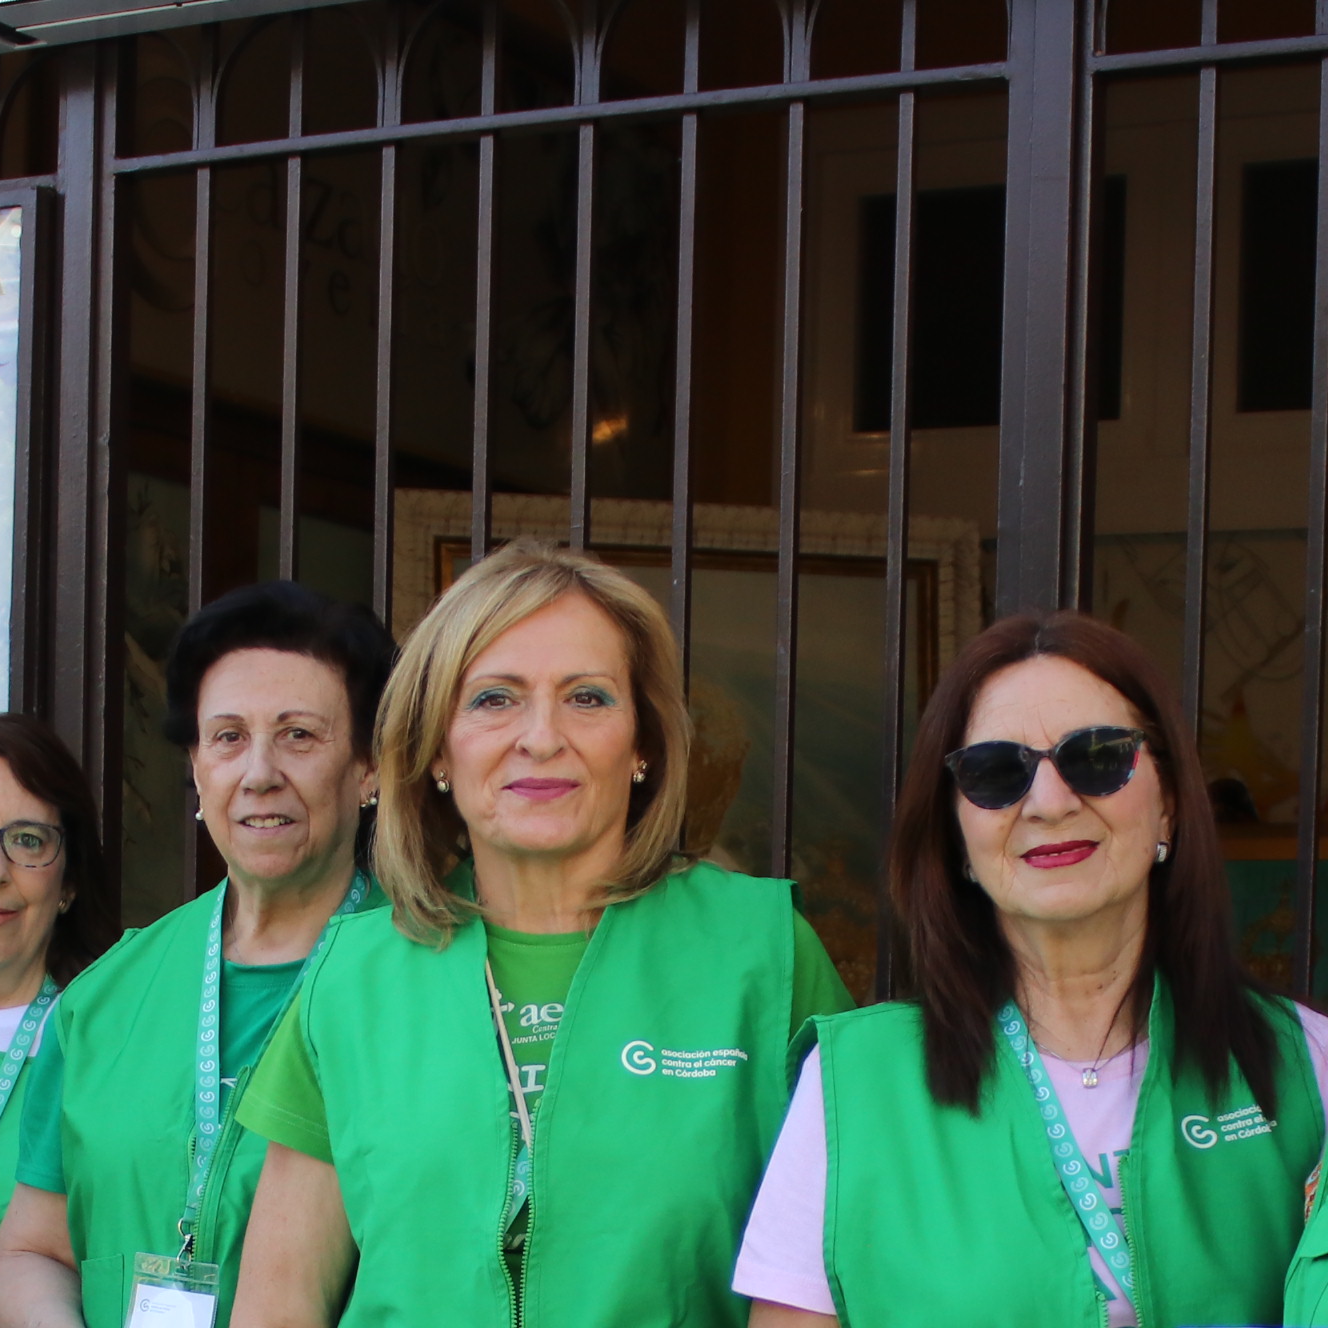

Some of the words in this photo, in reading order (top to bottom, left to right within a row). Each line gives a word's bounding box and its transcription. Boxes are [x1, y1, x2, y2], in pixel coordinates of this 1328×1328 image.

[512, 1034, 537, 1044] JUNTA
[539, 1032, 556, 1041] LOC
[661, 1049, 711, 1059] asociación
[713, 1048, 748, 1061] española
[662, 1058, 692, 1068] contra
[704, 1058, 736, 1066] cáncer
[675, 1069, 716, 1078] Córdoba
[1221, 1119, 1253, 1131] contra
